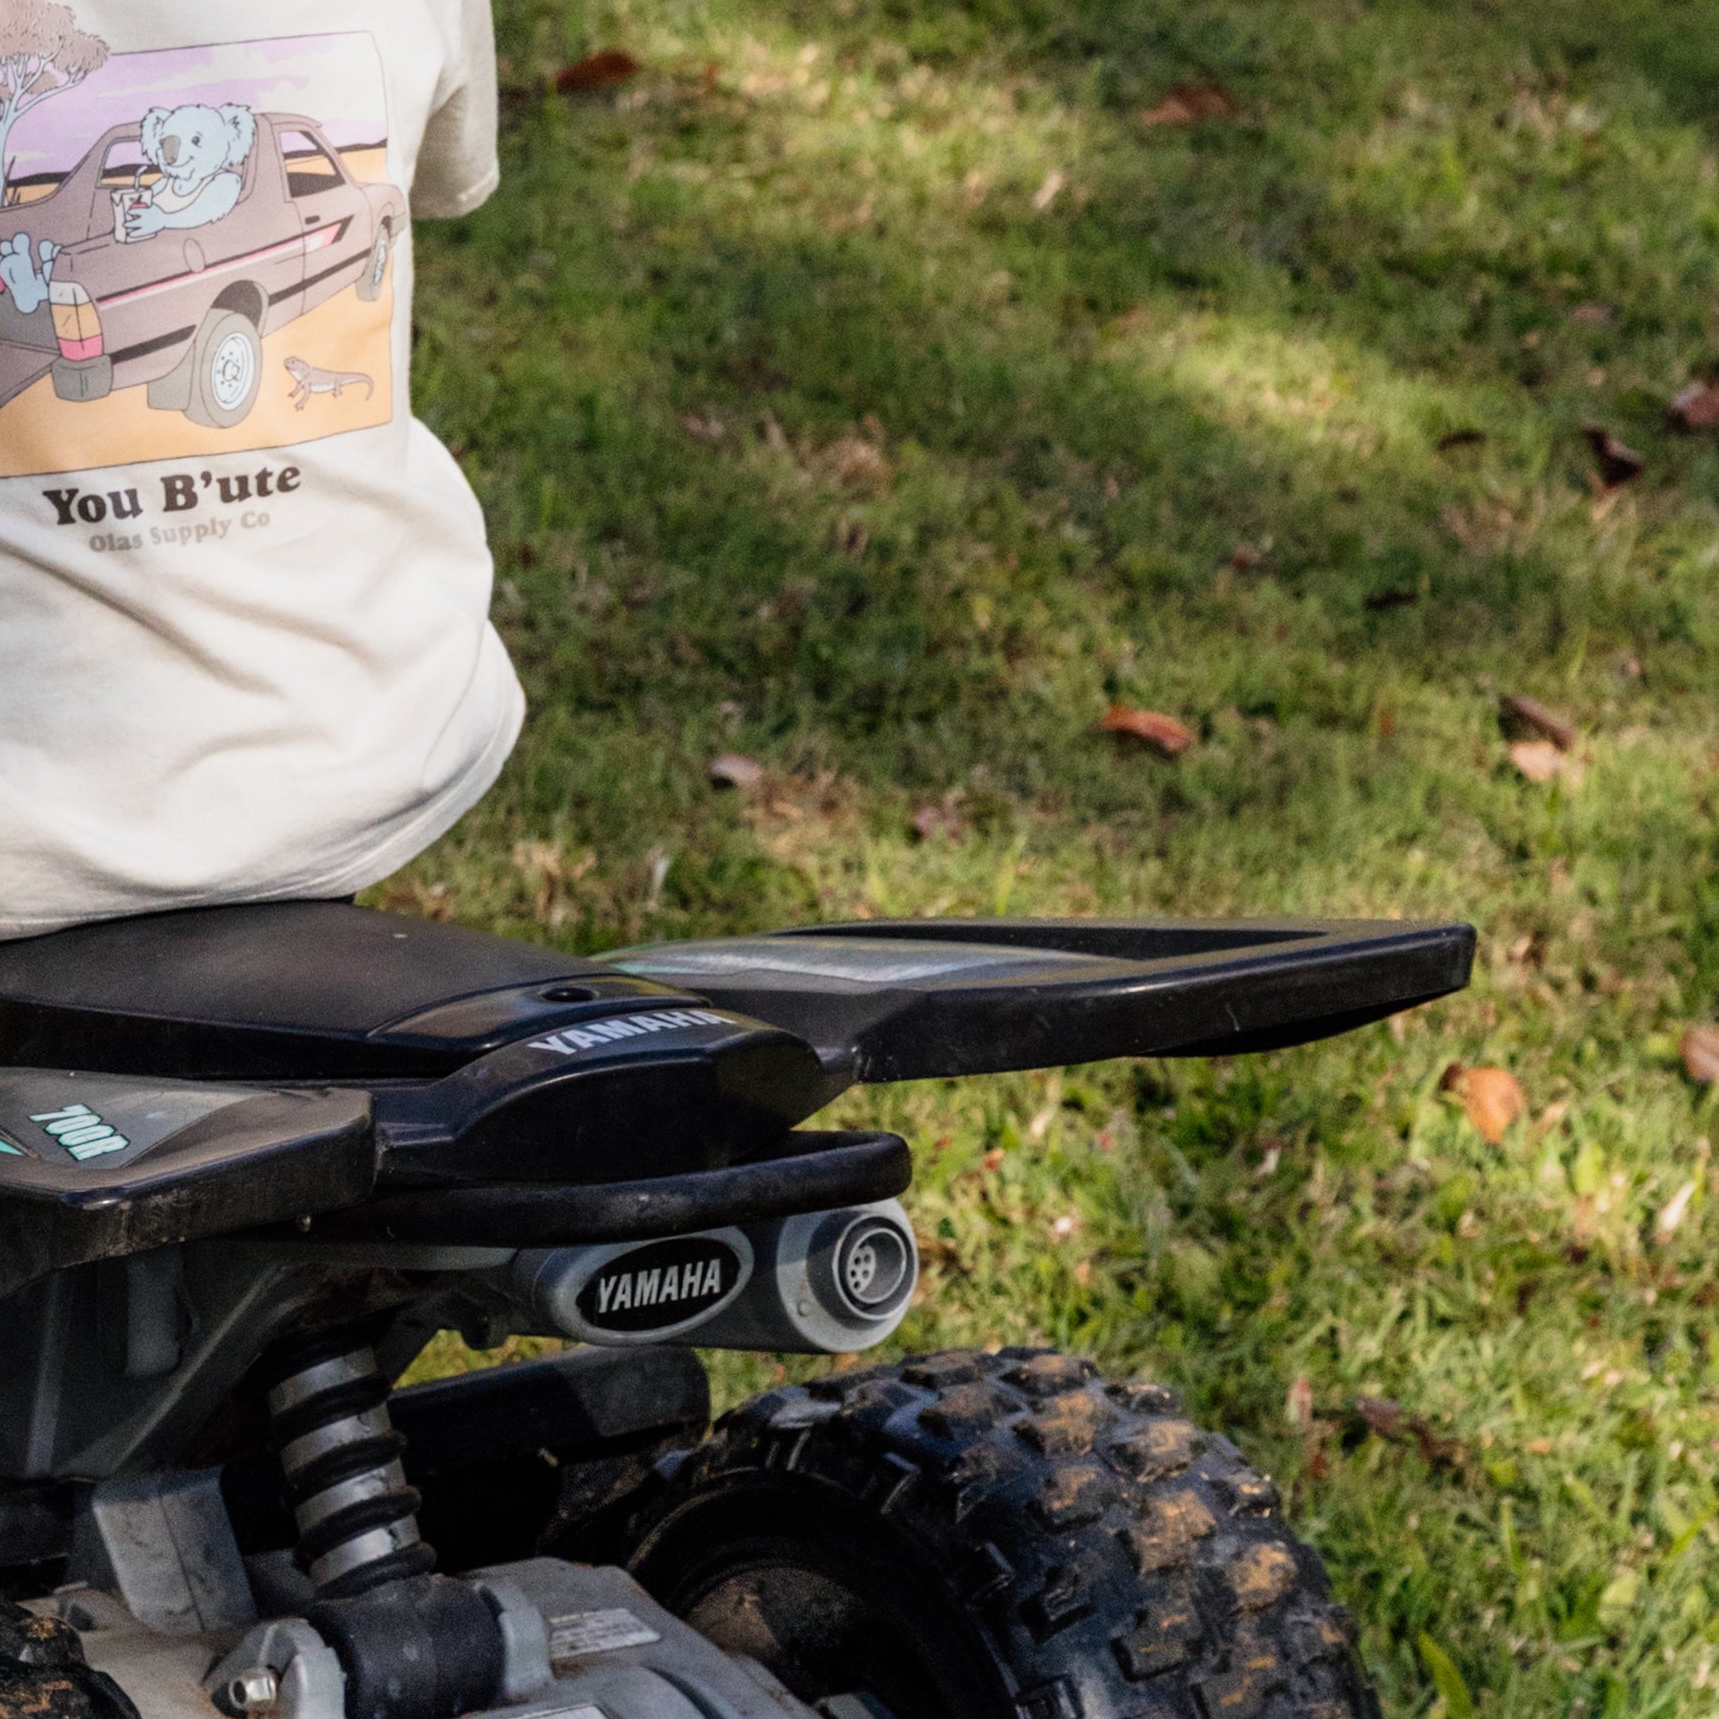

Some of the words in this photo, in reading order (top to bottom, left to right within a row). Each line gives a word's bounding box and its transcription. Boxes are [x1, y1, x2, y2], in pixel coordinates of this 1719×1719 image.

[42, 488, 144, 526] You
[160, 465, 301, 513] B'ute
[89, 532, 143, 553] Olas
[150, 517, 232, 545] Supply
[240, 512, 271, 530] Co
[527, 1010, 737, 1055] YAMAHA
[28, 1103, 129, 1161] 700R
[598, 1258, 721, 1314] YAMAHA
